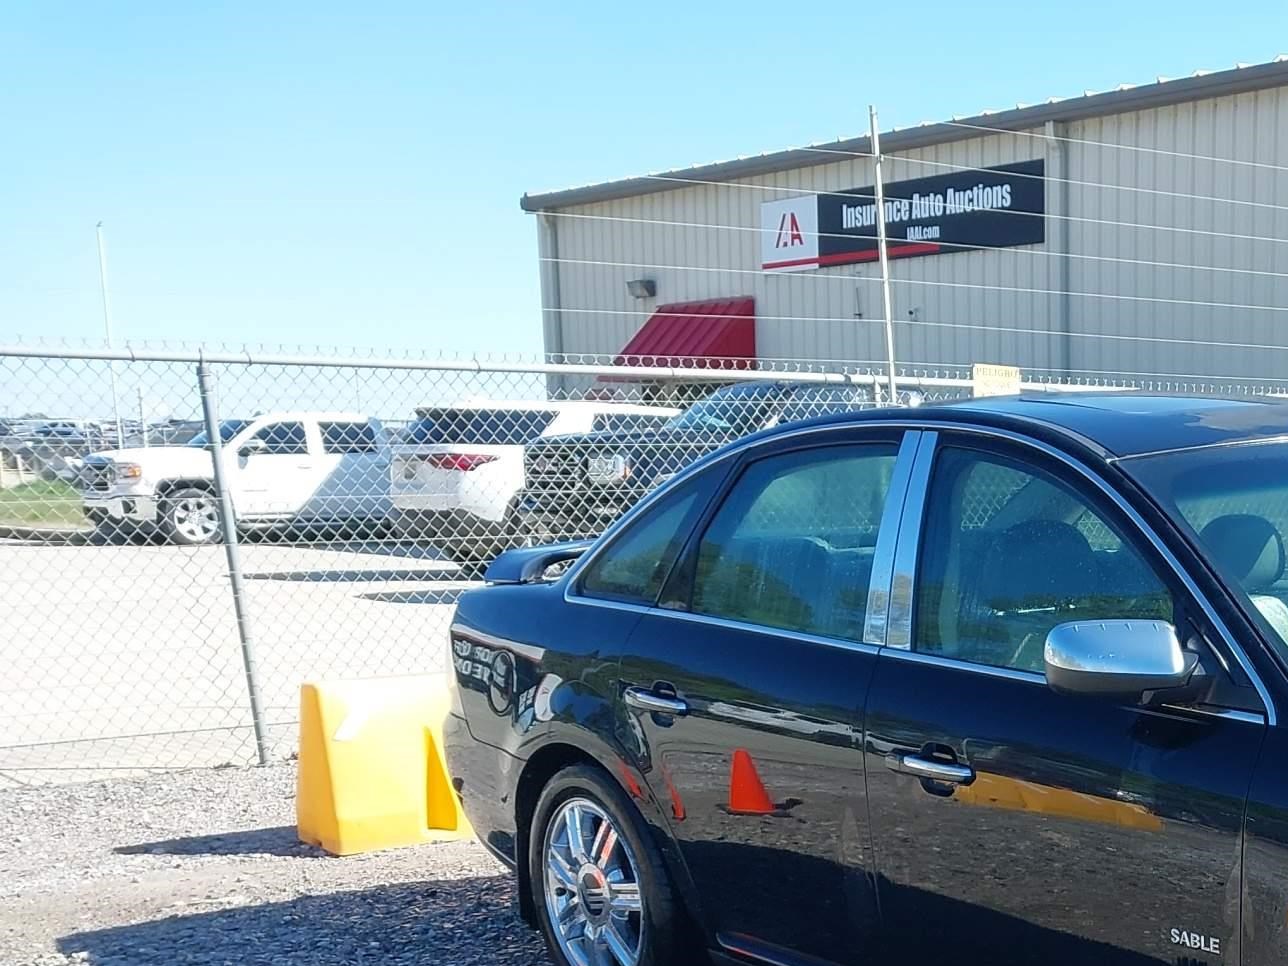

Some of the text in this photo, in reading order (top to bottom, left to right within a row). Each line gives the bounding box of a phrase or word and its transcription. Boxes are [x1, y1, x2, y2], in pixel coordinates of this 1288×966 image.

[842, 183, 1011, 229] Insurnce Auto Auctions
[1170, 927, 1221, 954] SABLE
